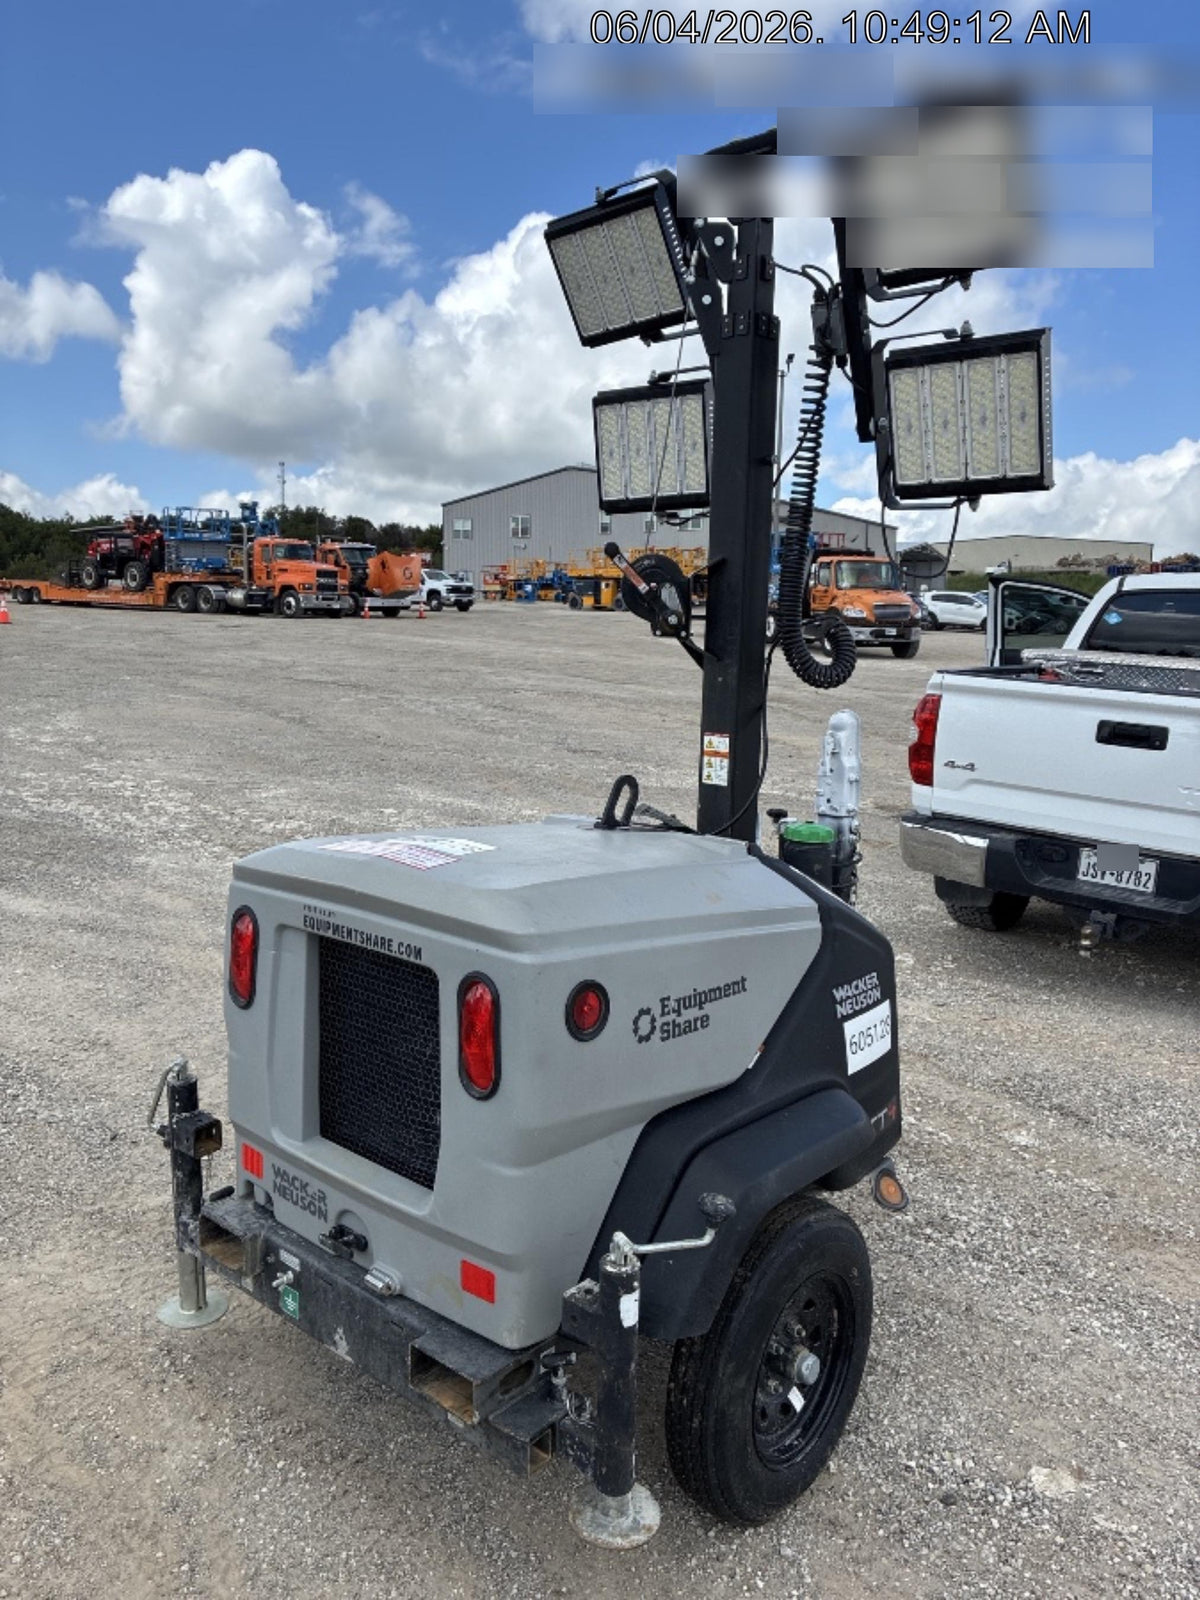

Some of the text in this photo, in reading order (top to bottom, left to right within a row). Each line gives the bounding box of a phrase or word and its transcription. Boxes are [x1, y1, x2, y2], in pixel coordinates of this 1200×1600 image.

[303, 914, 422, 962] EQUIPMENTSHARE.COM
[659, 975, 747, 1017] Equipment
[832, 972, 880, 1002] WACKER
[835, 987, 881, 1019] NEUSON
[659, 1013, 710, 1042] Share
[273, 1180, 328, 1223] NEUSON
